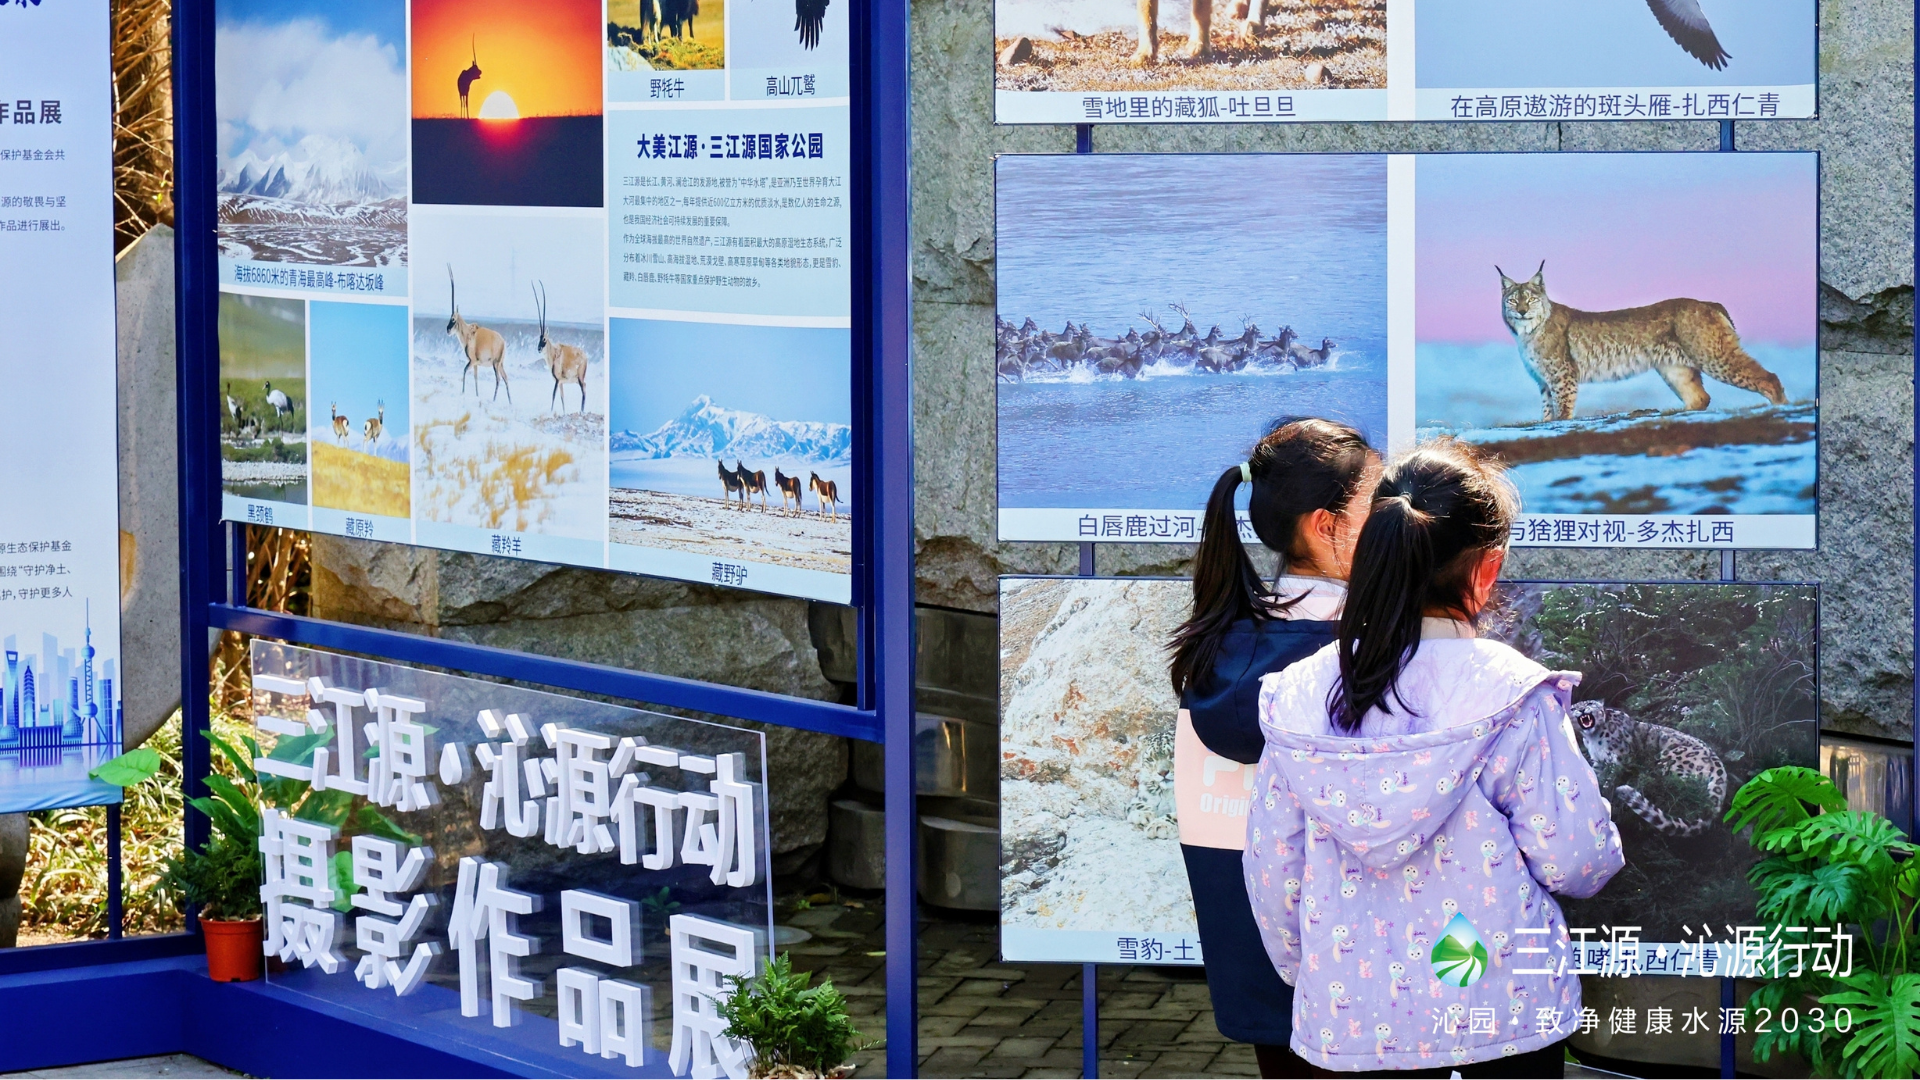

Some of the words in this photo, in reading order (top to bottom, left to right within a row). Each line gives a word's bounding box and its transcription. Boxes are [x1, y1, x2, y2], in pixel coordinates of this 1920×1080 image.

[650, 78, 685, 98] 野牦牛
[766, 74, 816, 97] 高山兀鹫
[1082, 96, 1296, 119] 雪地里的藏狐-吐旦旦
[1450, 92, 1781, 118] 在高原遨游的斑头雁-扎西仁青
[637, 133, 824, 160] 大美江源·三江源国家公园
[234, 264, 384, 292] 海拔6860米的青海最高峰-布喀达坂峰
[247, 504, 274, 525] 黑颈鹤
[345, 517, 374, 538] 藏原羚
[491, 534, 522, 556] 藏羚羊
[712, 562, 748, 586] 藏野驴
[259, 808, 757, 1079] 摄影作品展
[1117, 937, 1204, 961] 雪豹-土
